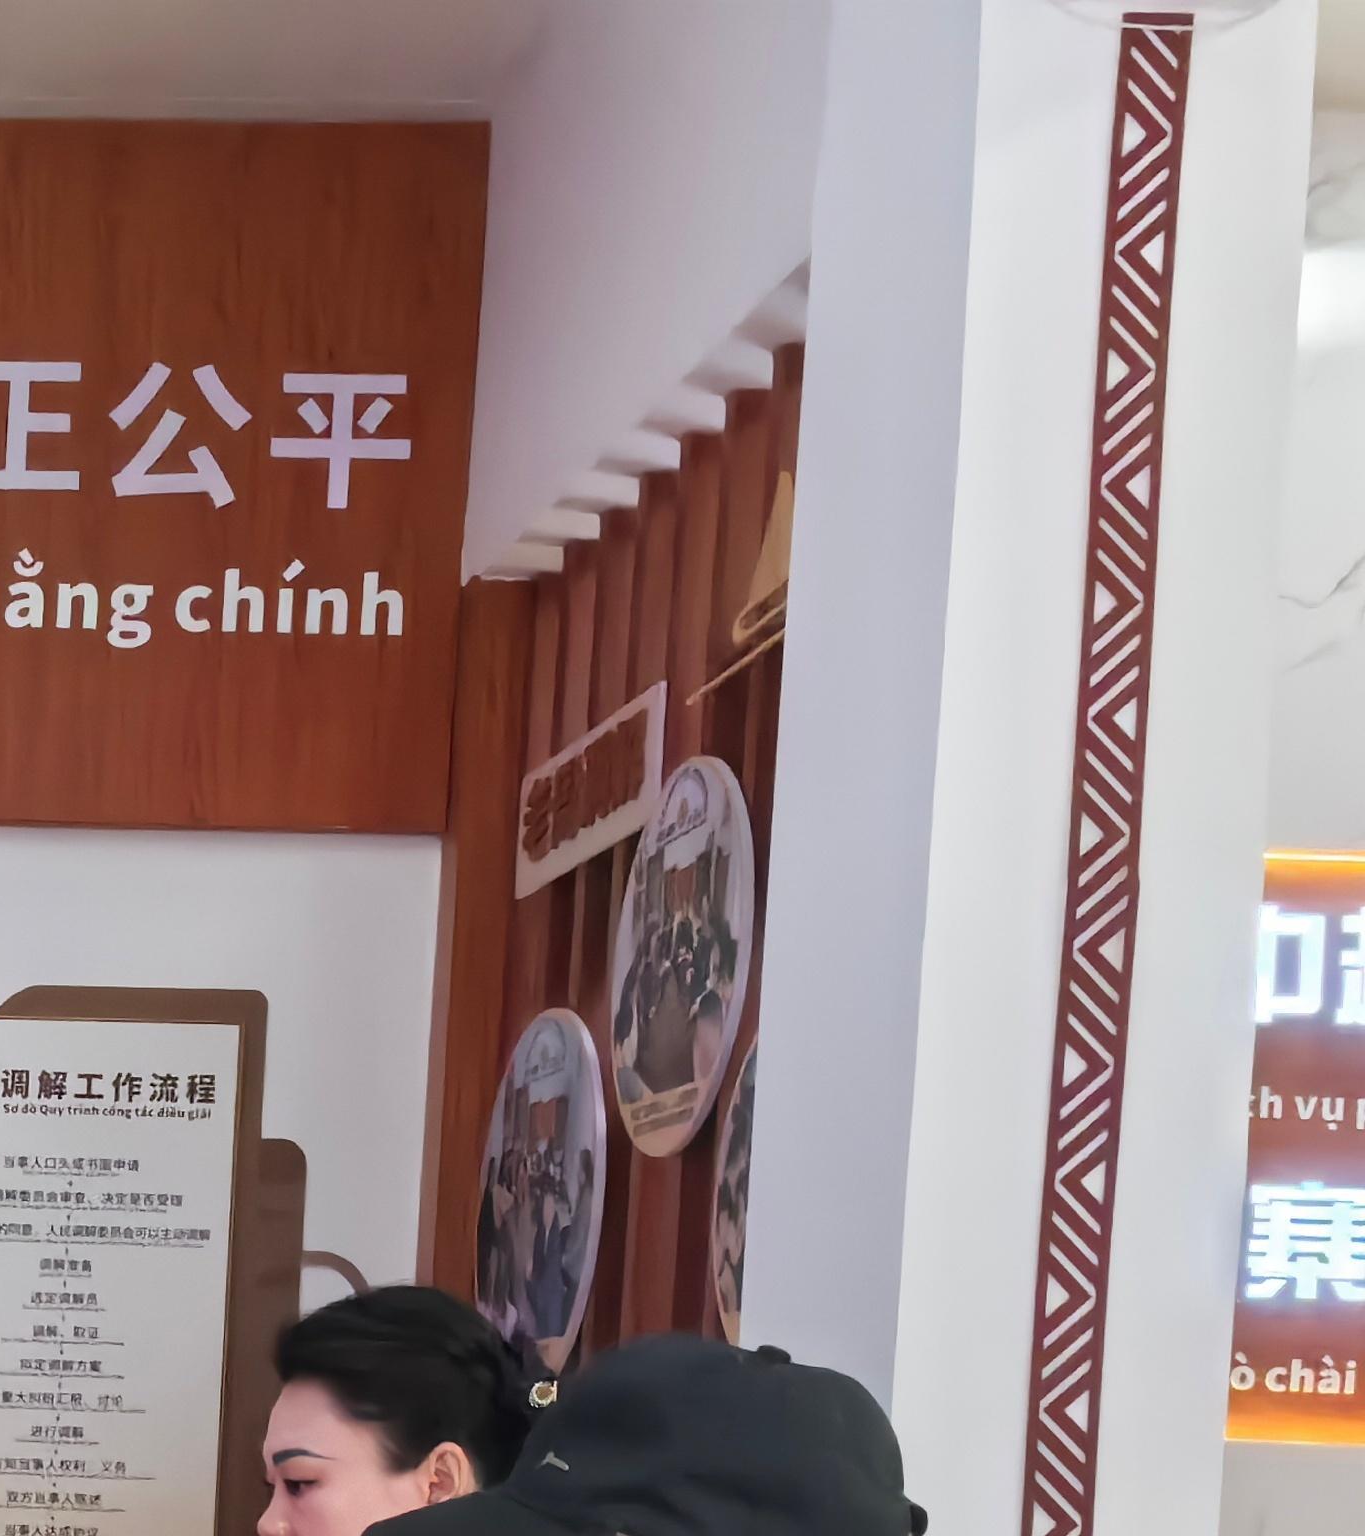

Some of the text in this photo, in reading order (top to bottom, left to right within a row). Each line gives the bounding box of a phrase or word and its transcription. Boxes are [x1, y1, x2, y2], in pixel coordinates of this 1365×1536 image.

[176, 558, 404, 636] chính
[1, 1069, 216, 1104] 调解工作流程
[1295, 1095, 1345, 1131] vụ
[1265, 1354, 1357, 1395] chài
